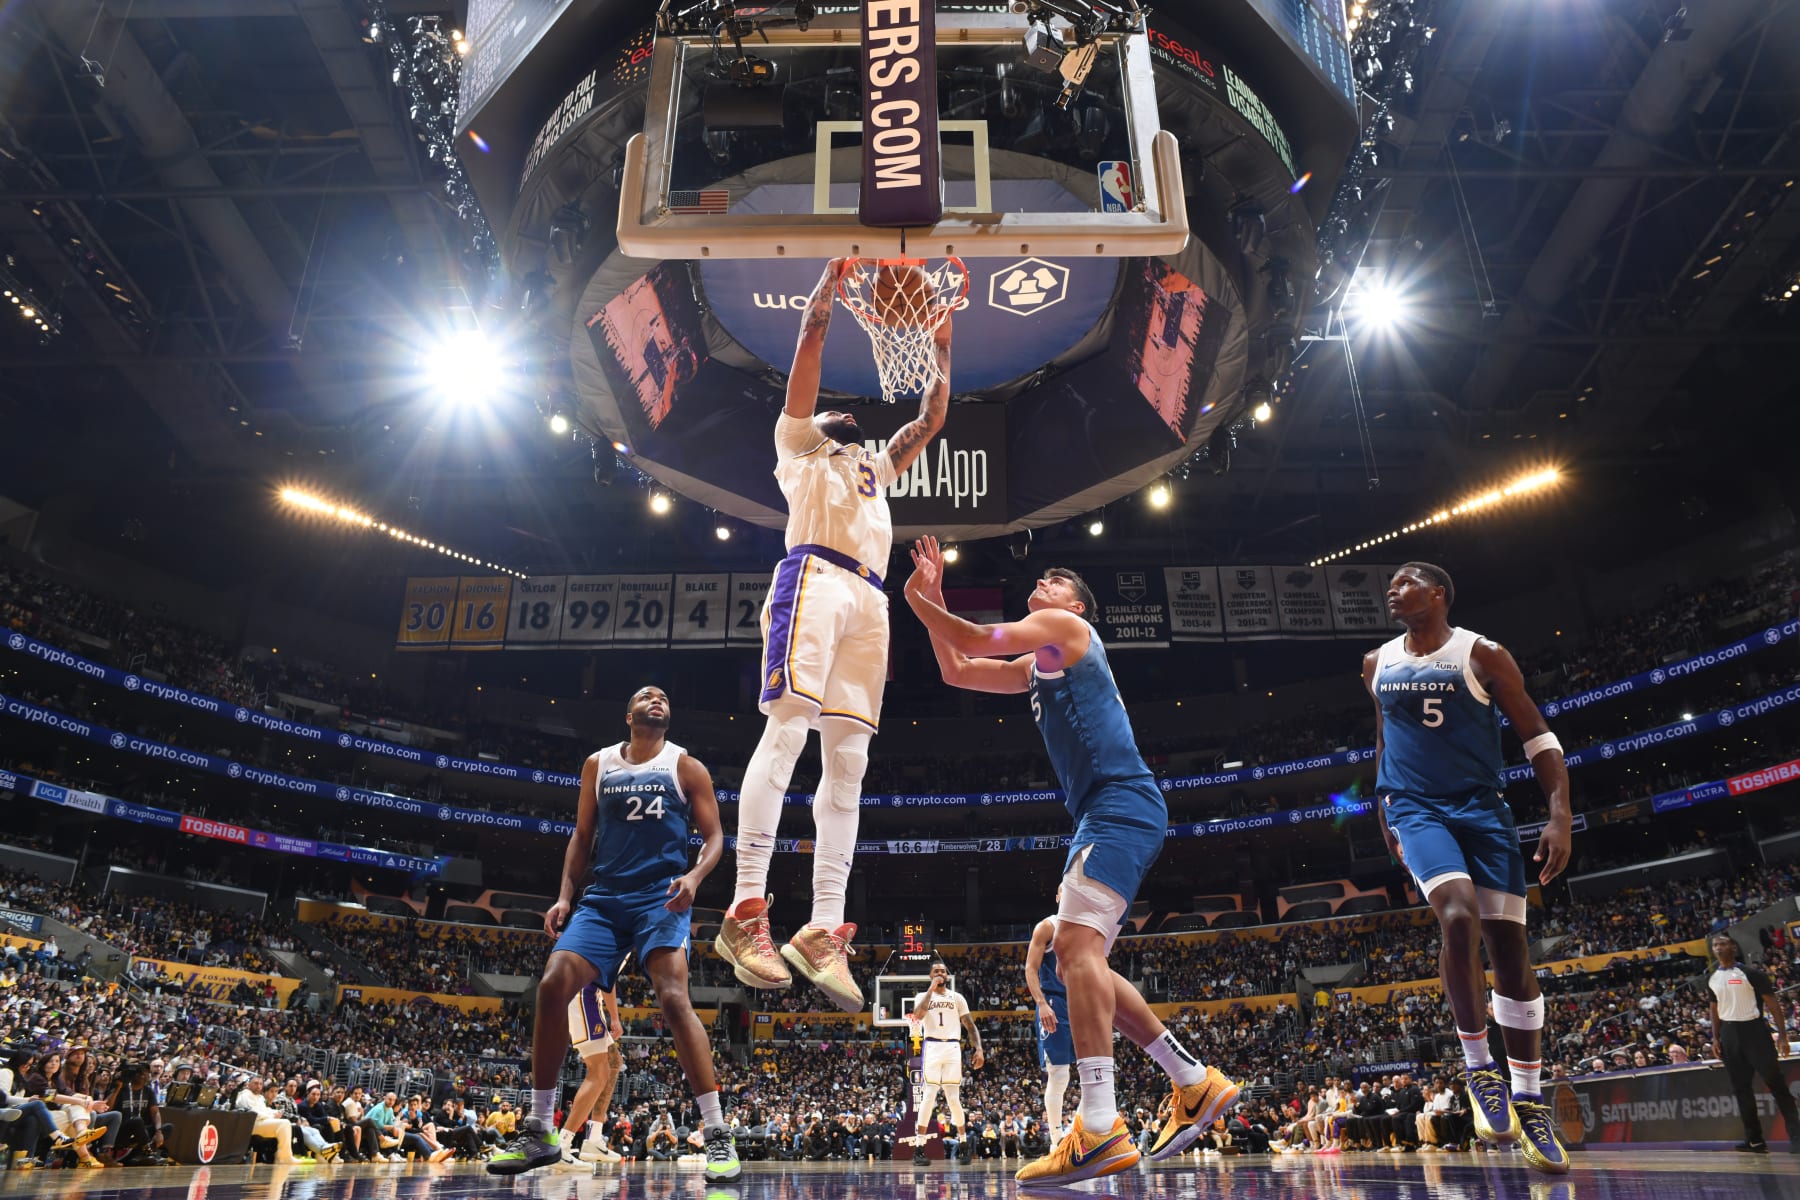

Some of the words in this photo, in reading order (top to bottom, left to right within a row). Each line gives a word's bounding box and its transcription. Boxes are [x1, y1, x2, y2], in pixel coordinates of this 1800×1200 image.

[563, 91, 574, 114] TO
[574, 70, 596, 102] FULL
[868, 0, 921, 189] ERS.COM
[1106, 203, 1122, 212] NBA
[858, 462, 878, 501] 3
[936, 438, 988, 508] App
[570, 583, 613, 592] GRETZKY
[621, 582, 670, 592] ROBITAILLE
[685, 582, 718, 591] BLAKE
[1120, 576, 1143, 585] LA
[406, 602, 446, 631] 30
[463, 602, 495, 631] 16
[519, 601, 550, 630] 18
[570, 600, 610, 630] 99
[622, 600, 664, 628] 20
[689, 600, 709, 628] 4
[1106, 605, 1142, 614] STANLEY
[1145, 605, 1162, 613] CUP
[1106, 614, 1164, 624] CHAMPIONS
[1116, 627, 1157, 638] 2011-12
[28, 642, 105, 679] crypto.com
[1669, 643, 1747, 676] crypto.com
[143, 681, 218, 712] crypto.com
[1380, 682, 1455, 692] MINNESOTA
[1562, 681, 1633, 711] crypto.com
[9, 702, 90, 736] crypto.com
[1422, 698, 1444, 728] 5
[252, 713, 321, 740] crypto.com
[1618, 722, 1697, 752] crypto.com
[130, 739, 209, 768] crypto.com
[355, 739, 420, 761] crypto.com
[452, 759, 517, 777] crypto.com
[1267, 757, 1331, 776] crypto.com
[245, 769, 316, 793] crypto.com
[1175, 773, 1238, 789] crypto.com
[1732, 764, 1800, 792] TOSHIBA
[40, 786, 63, 800] UCLA
[67, 794, 102, 810] Health
[604, 785, 665, 794] MINNESOTA
[995, 792, 1056, 803] crypto.com
[1693, 786, 1725, 799] ULTRA
[353, 792, 421, 813] crypto.com
[626, 796, 665, 821] 24
[906, 796, 966, 806] crypto.com
[1304, 800, 1372, 820] crypto.com
[128, 808, 173, 824] crypto.com
[454, 810, 522, 828] crypto.com
[1208, 817, 1272, 834] crypto.com
[184, 818, 245, 841] TOSHIBA
[894, 842, 922, 853] 16.6
[987, 841, 1000, 850] 28
[352, 852, 377, 862] ULTRA
[399, 858, 438, 873] DELTA
[939, 1012, 943, 1026] 1
[1370, 1062, 1410, 1072] CHAMPIONS
[1601, 1099, 1677, 1123] SATURDAY
